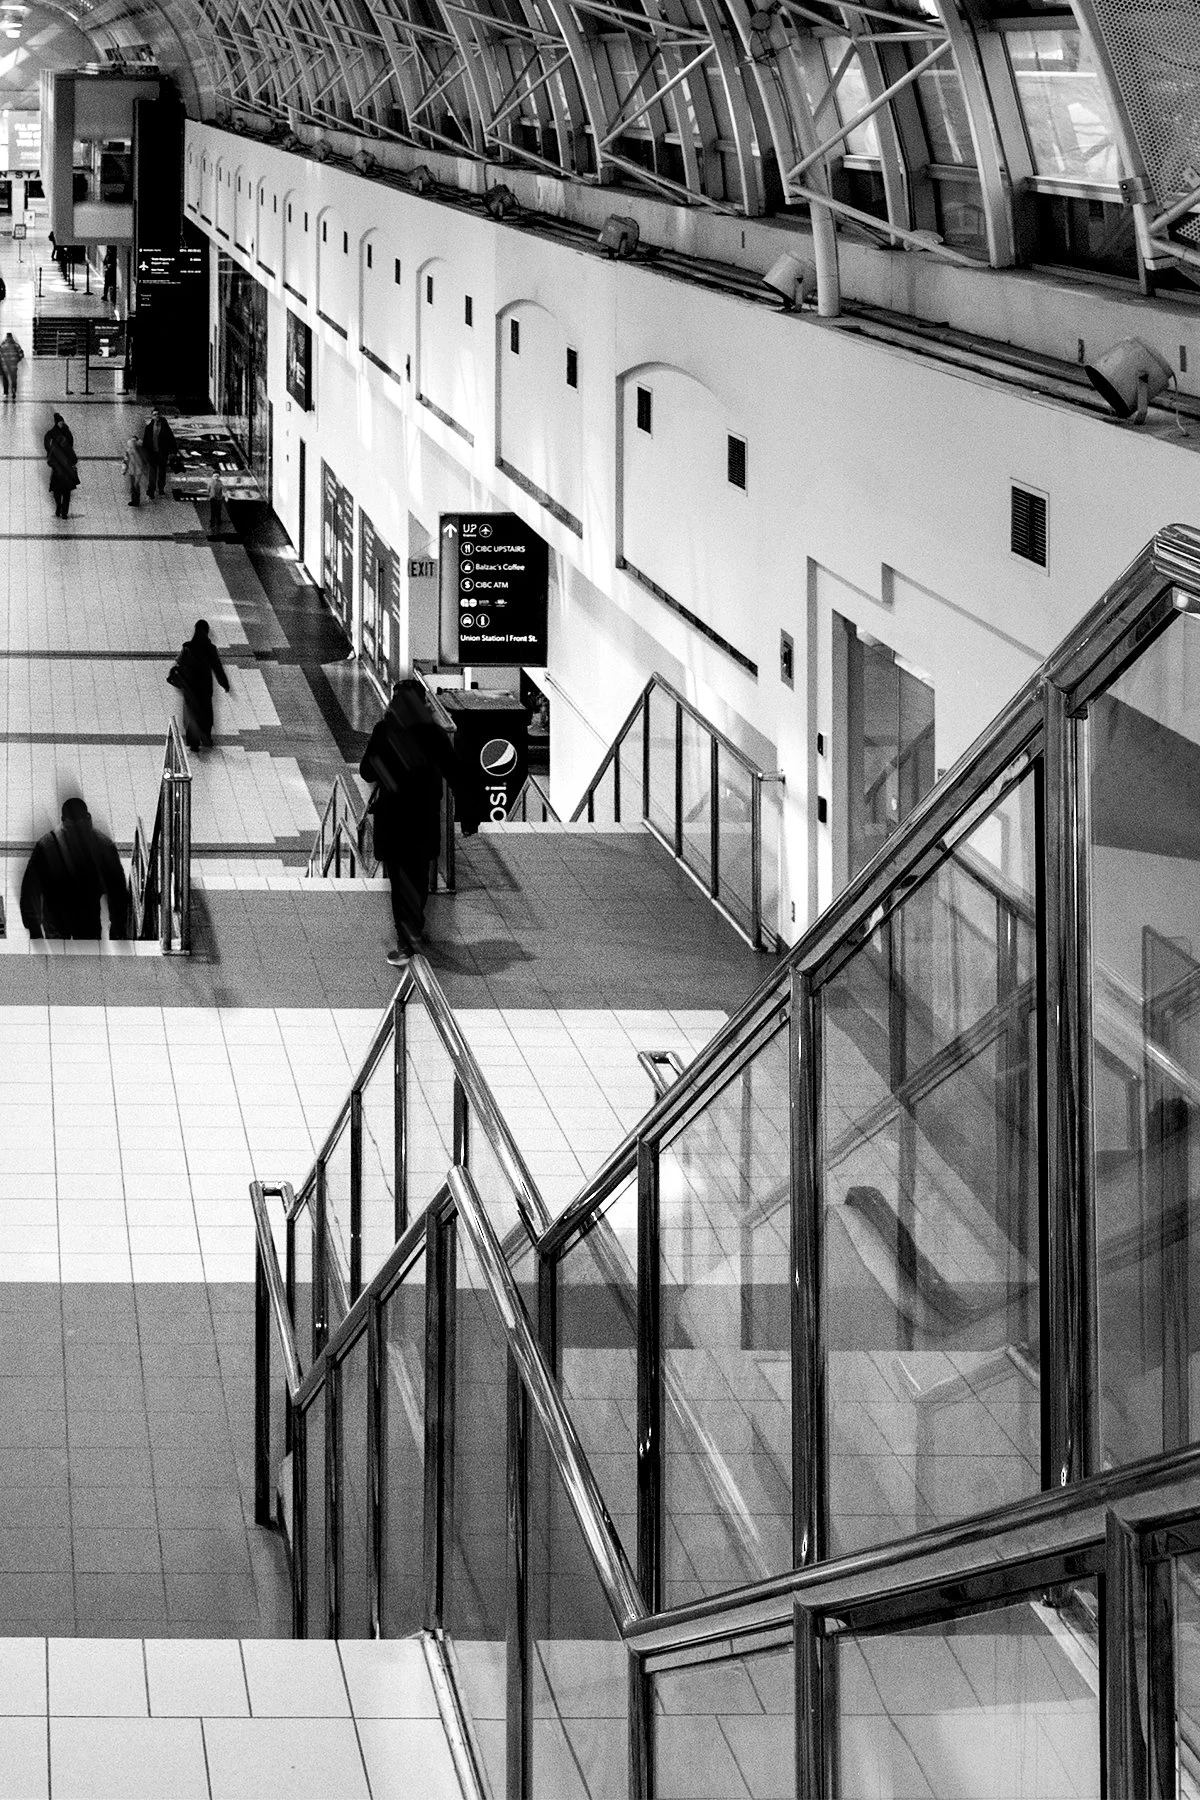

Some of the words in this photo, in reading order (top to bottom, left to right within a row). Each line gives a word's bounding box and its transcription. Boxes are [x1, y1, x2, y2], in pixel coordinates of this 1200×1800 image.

[475, 545, 493, 553] CIBC
[493, 545, 526, 553] UPSTAIRS
[411, 561, 435, 577] EXIT
[475, 563, 502, 571] Balzac's
[502, 563, 526, 571] Coffee
[475, 581, 493, 589] CIBC
[493, 581, 509, 589] ATM
[460, 634, 481, 642] Union
[481, 634, 505, 642] Station
[509, 634, 528, 642] Front
